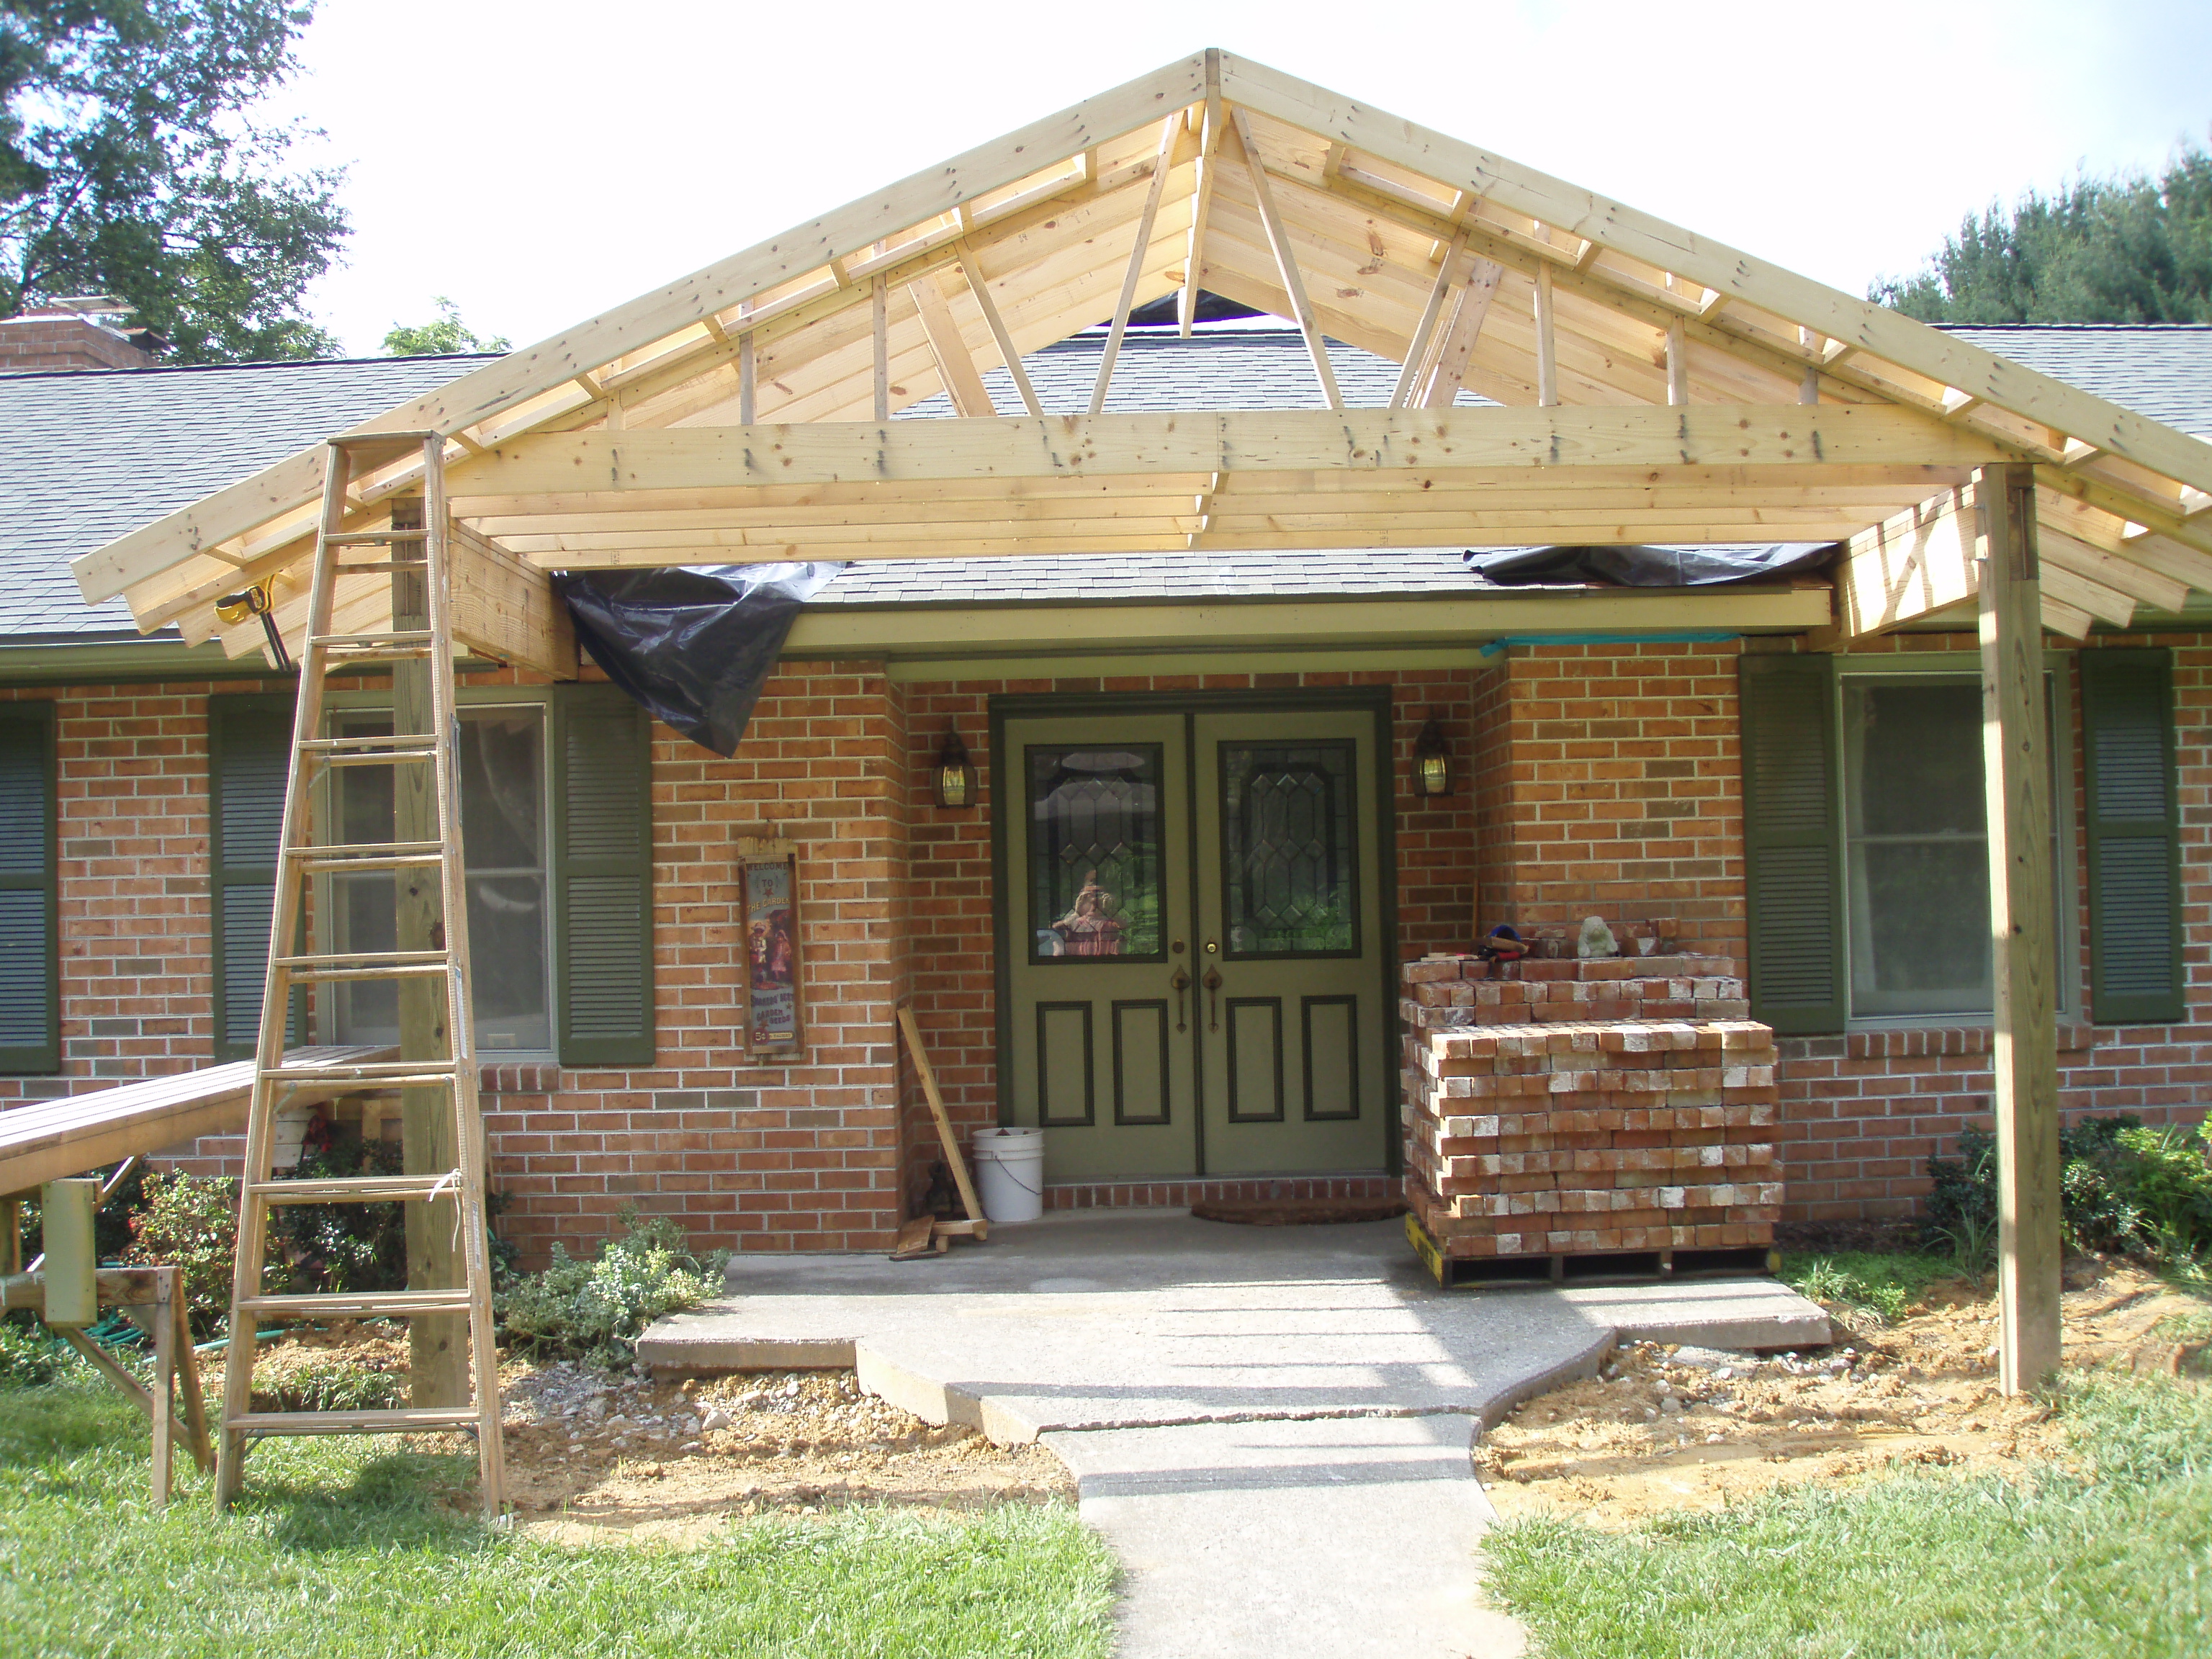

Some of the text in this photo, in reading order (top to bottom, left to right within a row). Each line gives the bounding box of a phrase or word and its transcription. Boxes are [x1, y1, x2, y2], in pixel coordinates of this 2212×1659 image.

[747, 897, 791, 914] THE GARDEN
[757, 1010, 783, 1022] GARDEN
[770, 1015, 791, 1024] SEEDS
